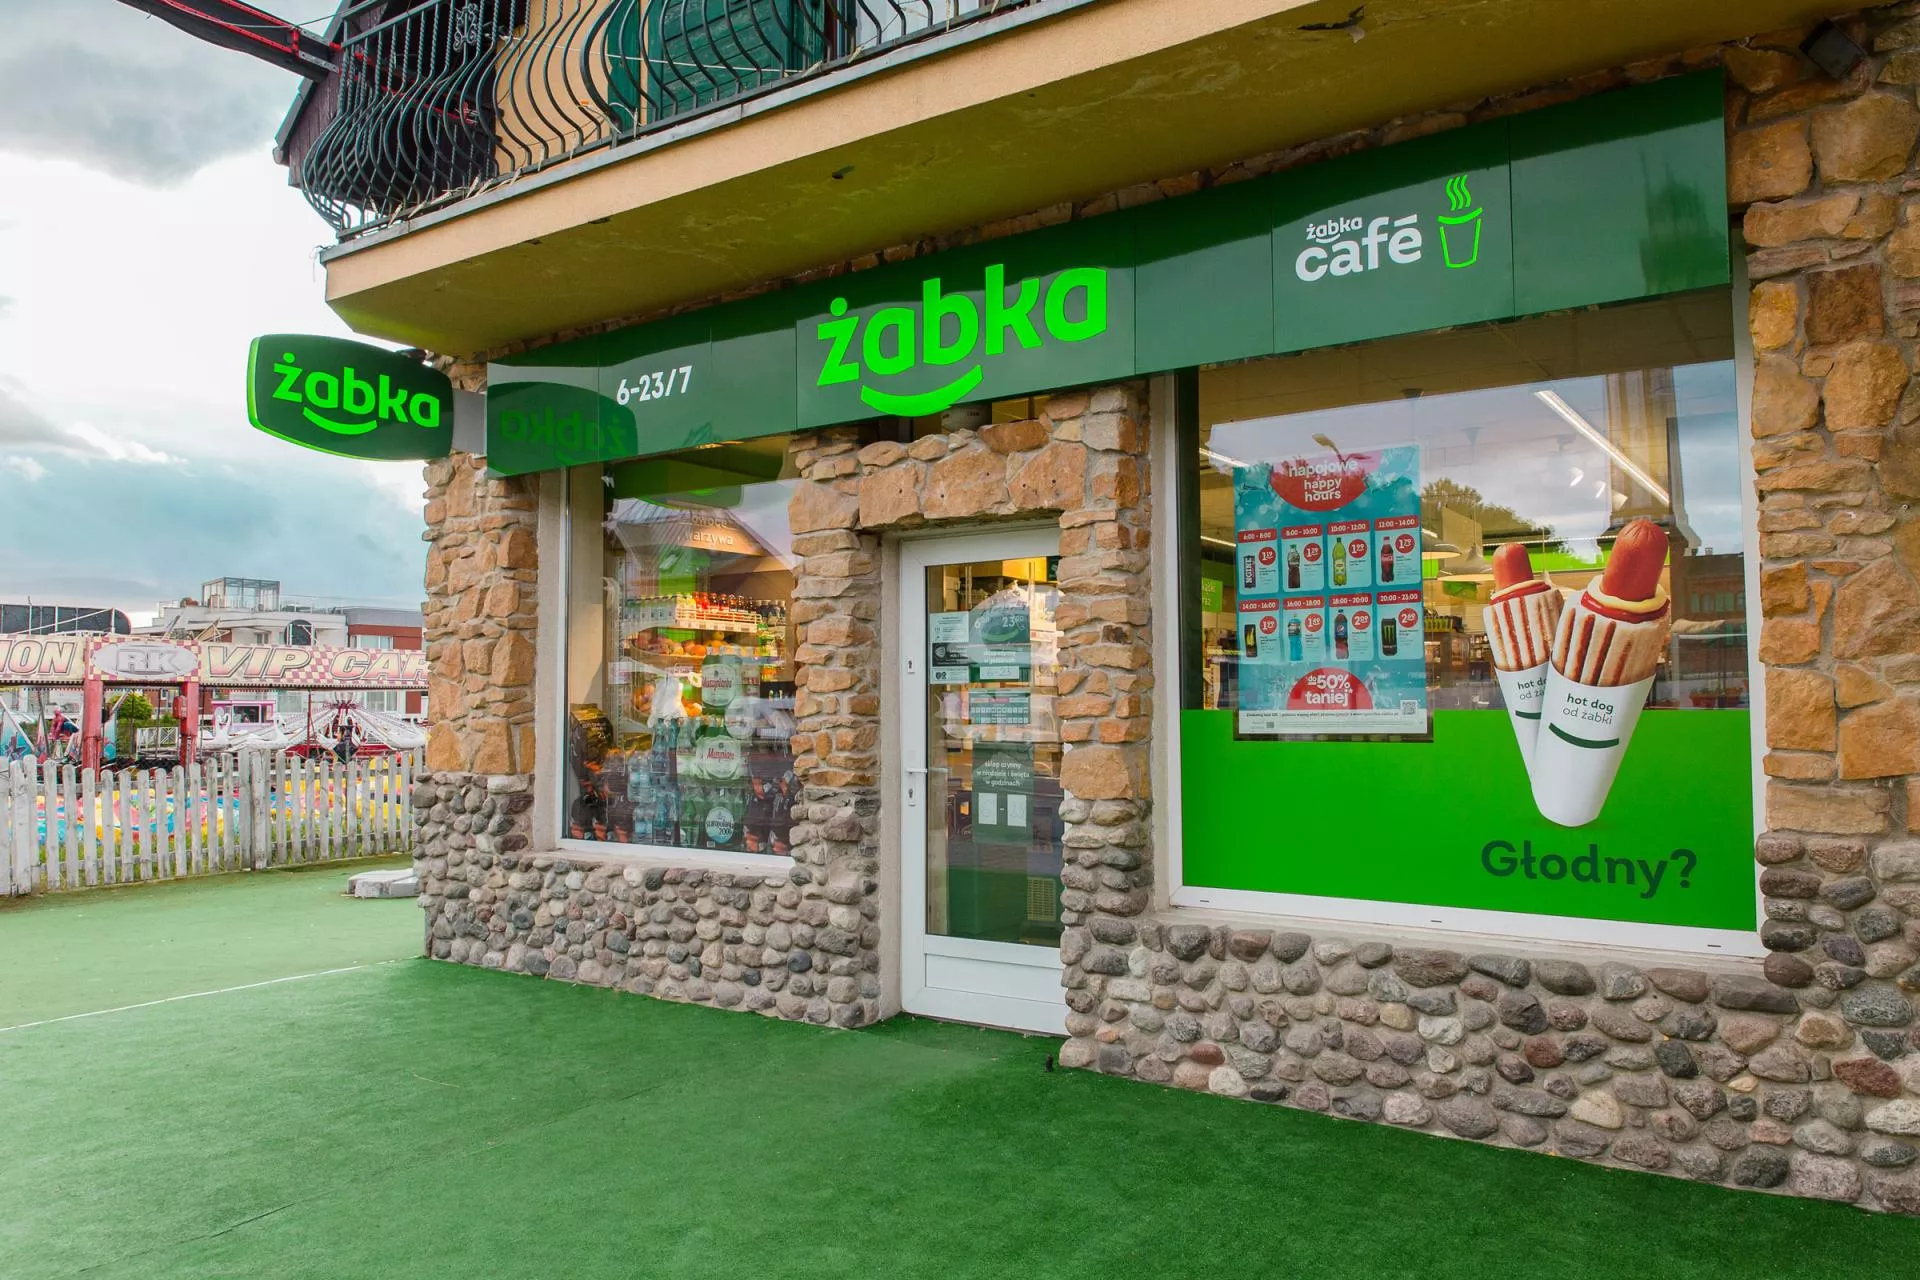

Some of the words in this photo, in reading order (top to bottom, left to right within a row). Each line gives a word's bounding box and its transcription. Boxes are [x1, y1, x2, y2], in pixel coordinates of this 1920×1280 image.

[1306, 217, 1363, 240] żabka
[817, 264, 1108, 386] żabka
[272, 352, 441, 428] żabka
[616, 365, 693, 405] 6-23/7
[1288, 459, 1358, 479] napojowe
[1304, 478, 1342, 491] happy
[1305, 490, 1342, 502] hours
[116, 649, 182, 674] RK
[207, 646, 312, 678] VIP
[1317, 674, 1350, 690] 50%
[1517, 680, 1534, 690] hot
[1520, 691, 1532, 700] od
[1566, 692, 1588, 707] hot
[1590, 699, 1614, 715] dog
[1562, 707, 1579, 718] od
[1581, 711, 1612, 725] żabki
[1481, 840, 1698, 900] Głodny?
